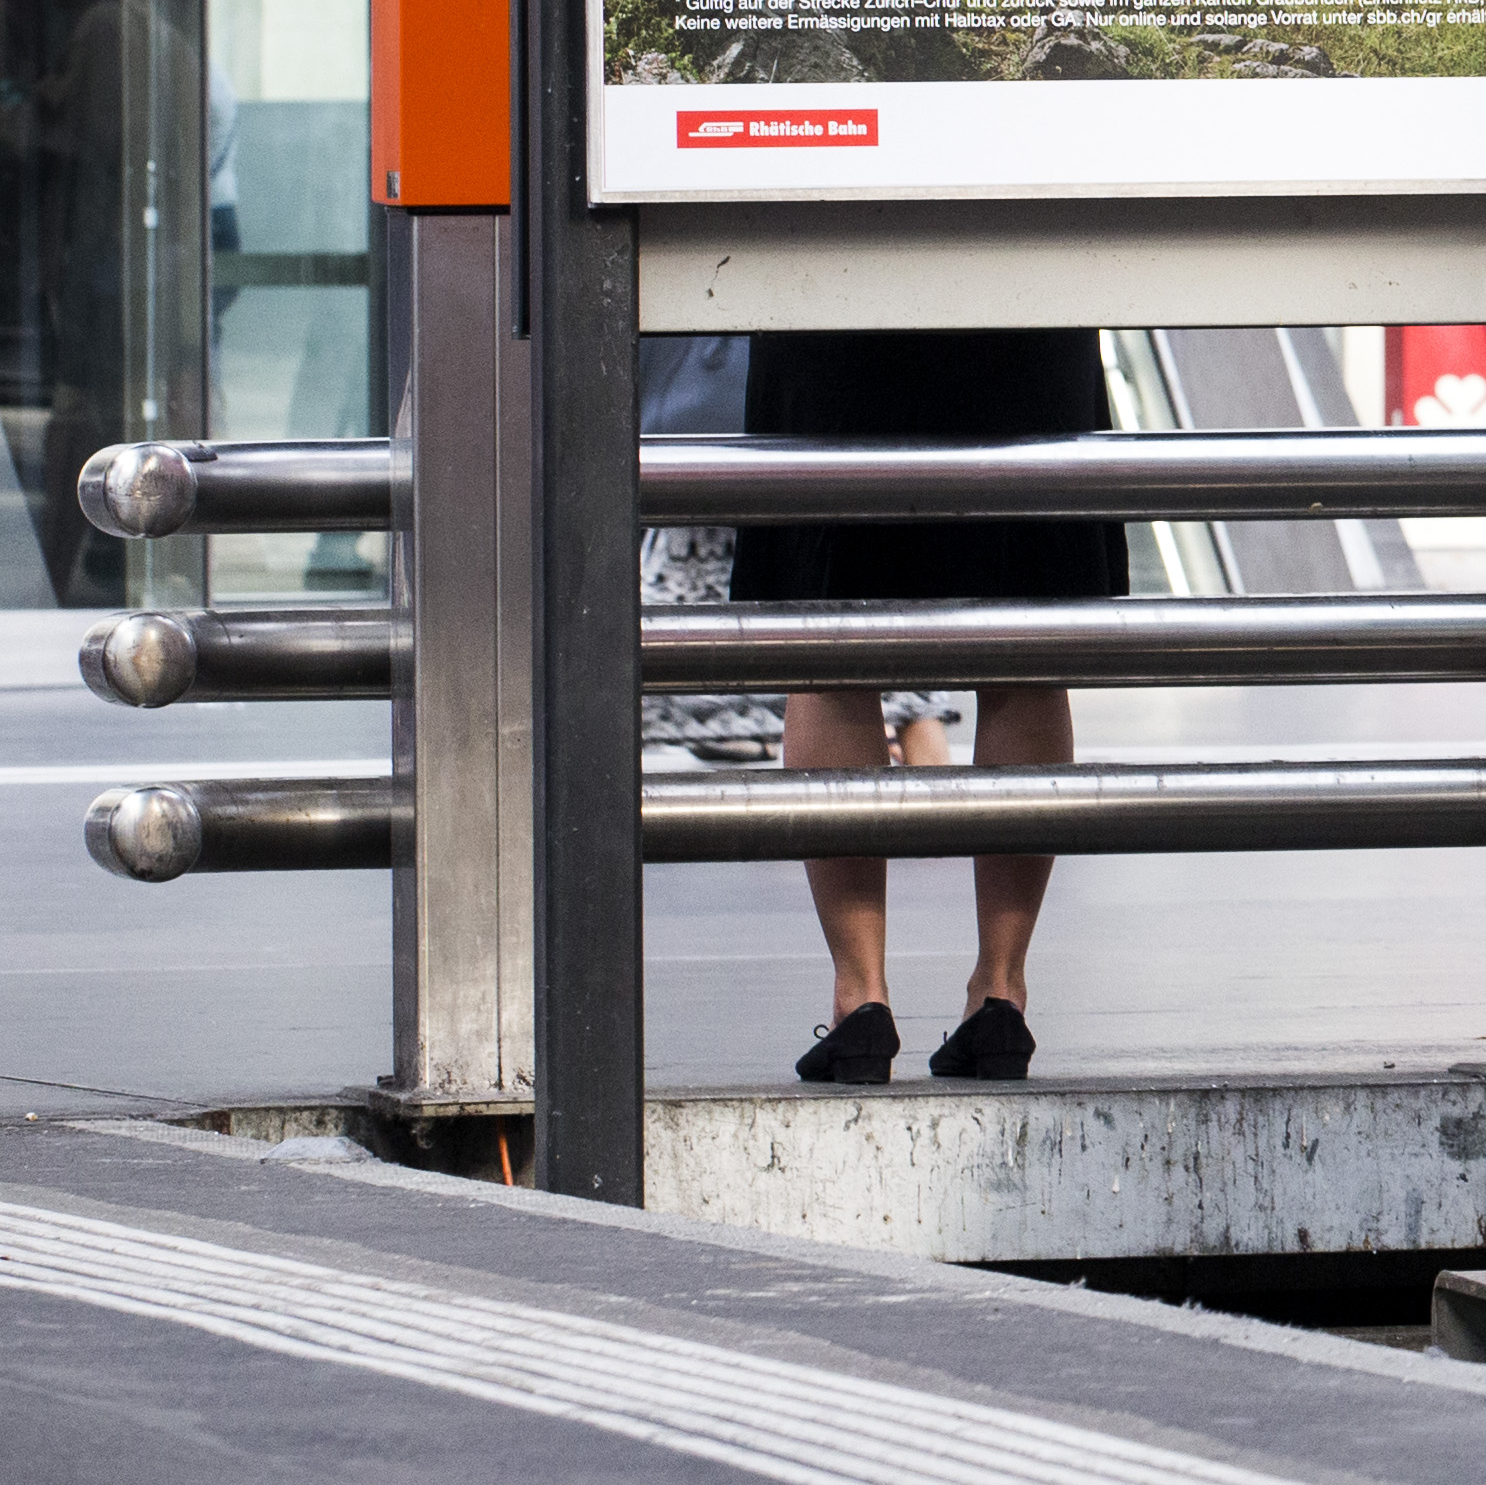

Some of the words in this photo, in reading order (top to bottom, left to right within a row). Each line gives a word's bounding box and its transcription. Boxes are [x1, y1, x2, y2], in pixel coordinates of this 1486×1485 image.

[674, 15, 721, 29] Keine
[724, 14, 784, 29] weitere
[786, 14, 911, 32] Ermässigungen
[914, 13, 940, 28] mit
[943, 13, 1006, 27] Halbtax
[1009, 12, 1048, 27] oder
[1051, 12, 1082, 27] GA.
[1085, 12, 1115, 26] Nur
[1118, 12, 1167, 26] online
[1170, 11, 1201, 26] und
[1204, 11, 1268, 30] solange
[1270, 11, 1318, 25] Vorrat
[1321, 10, 1363, 25] unter
[1366, 10, 1443, 28] sbb.ch/gr
[750, 121, 823, 136] Rhätische
[828, 120, 867, 135] Bahn
